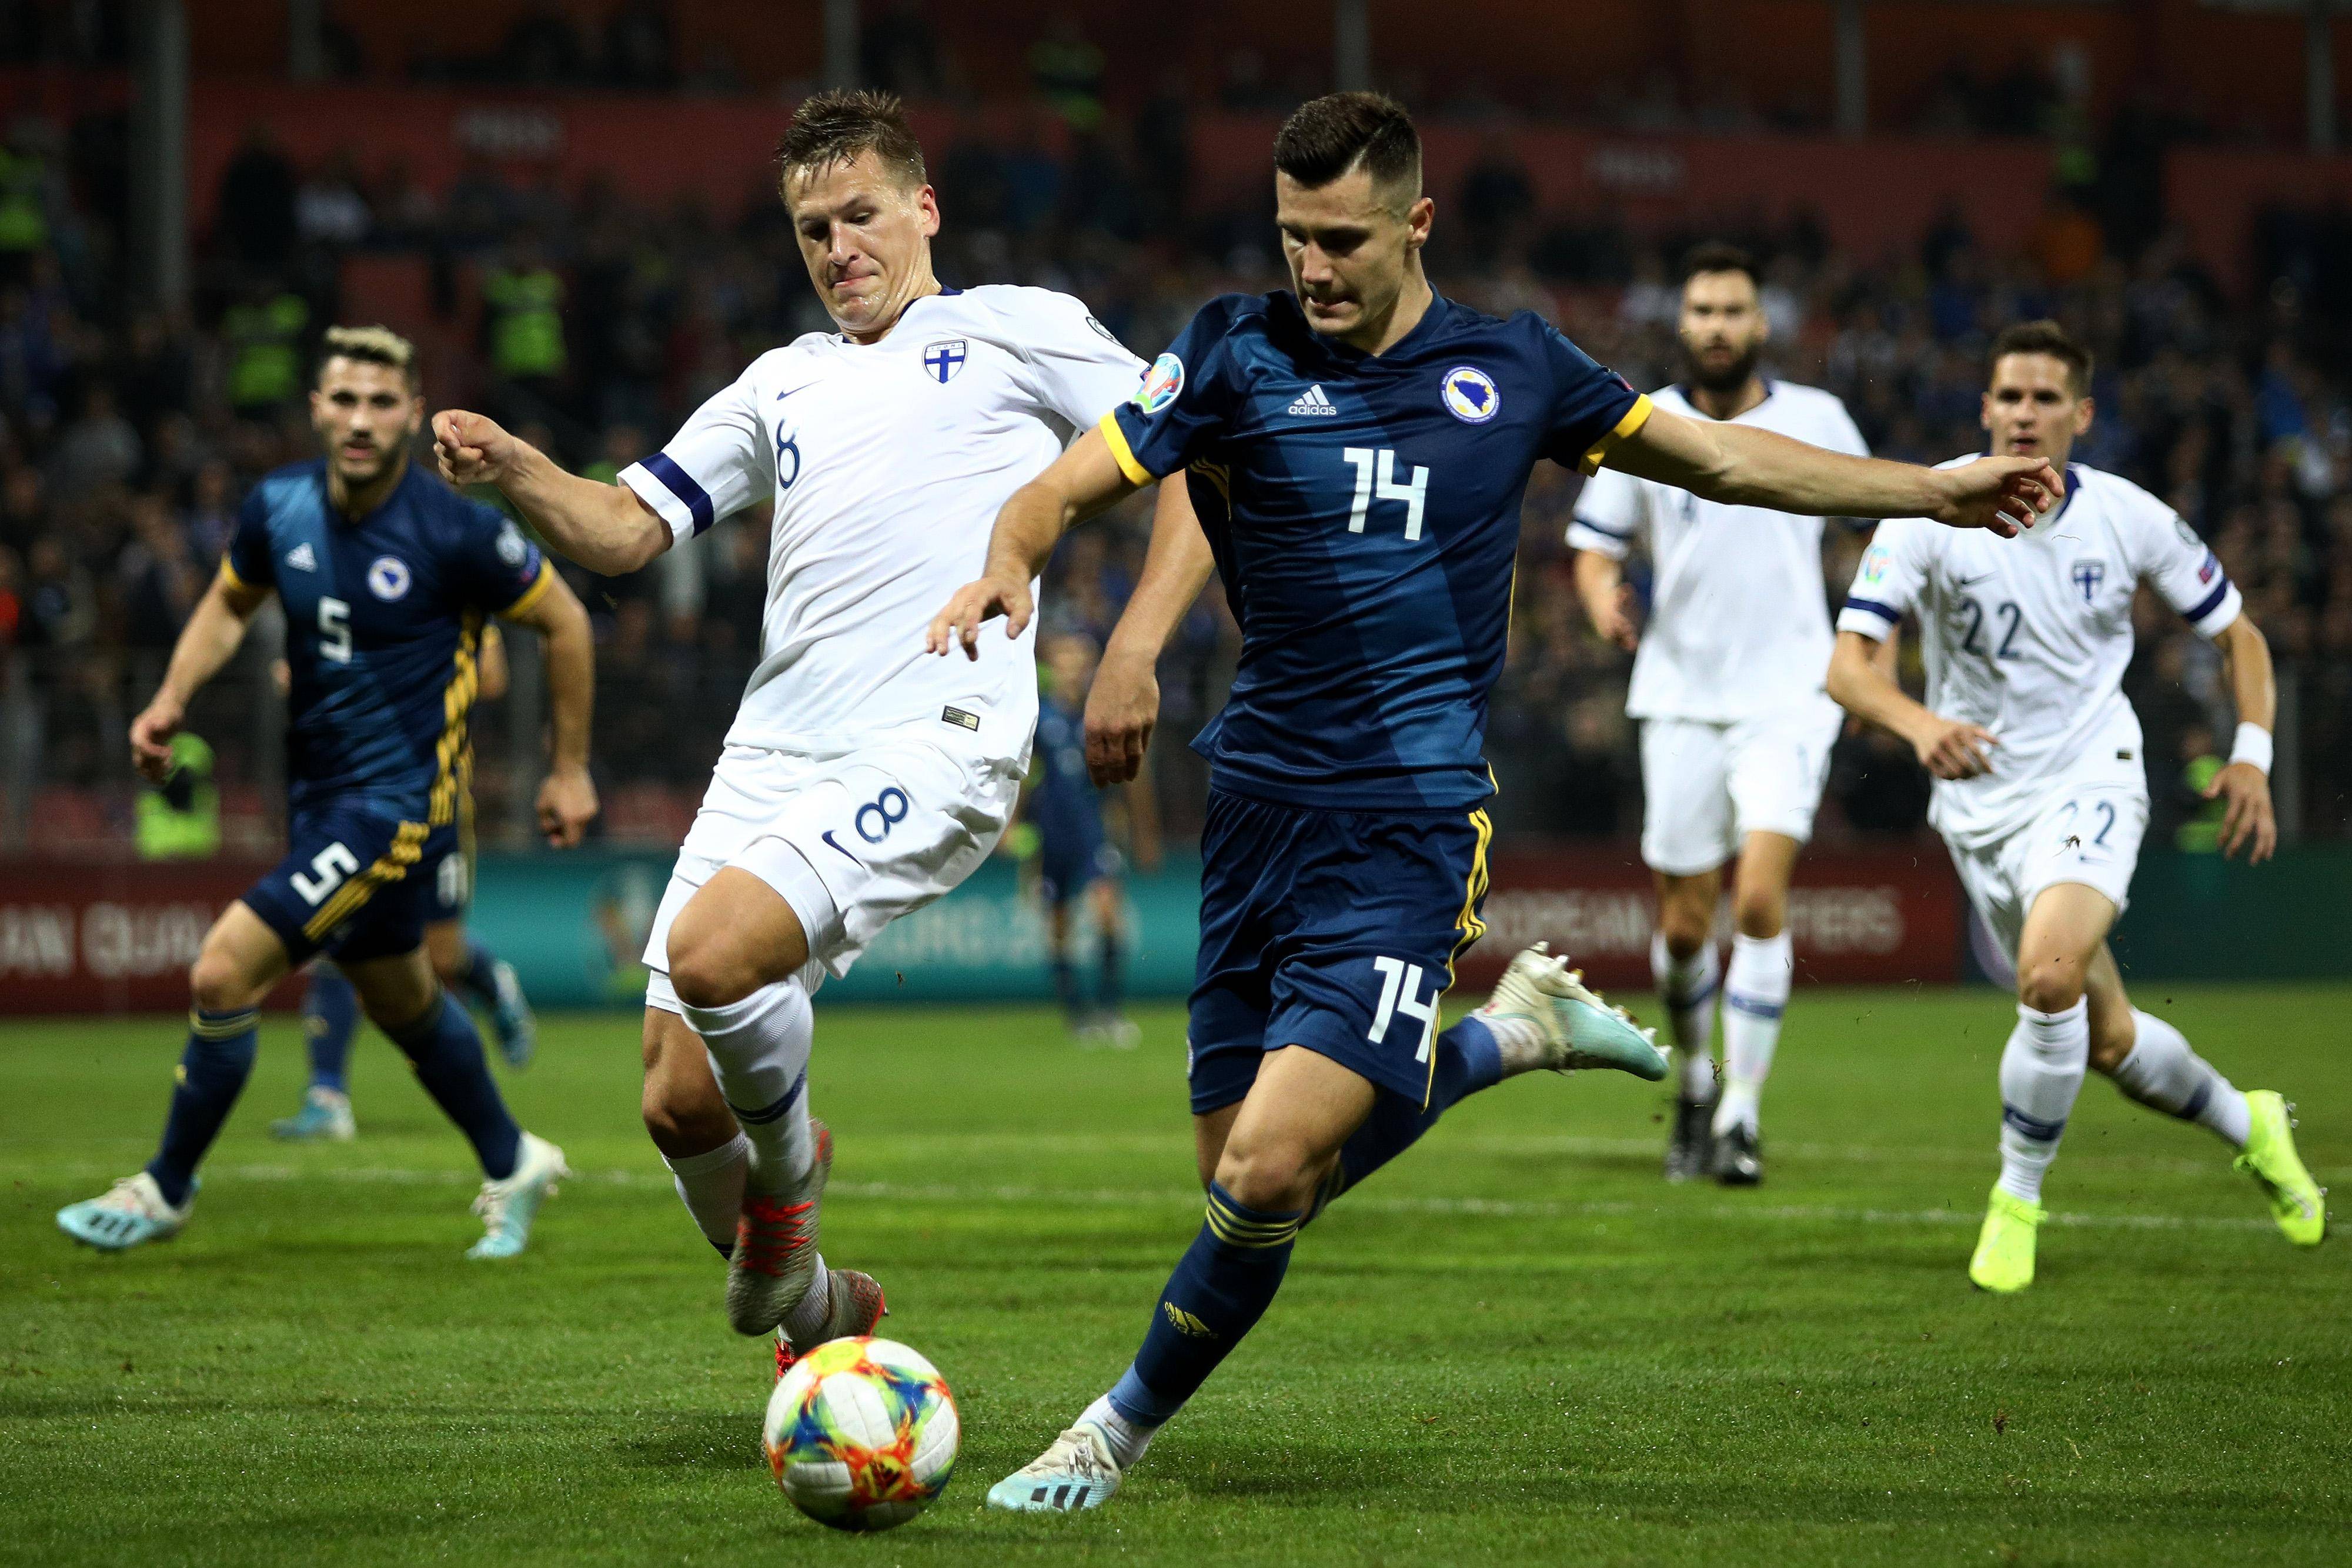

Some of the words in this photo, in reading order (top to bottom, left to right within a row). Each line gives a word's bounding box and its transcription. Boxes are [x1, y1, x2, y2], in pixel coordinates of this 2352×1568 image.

[1288, 404, 1337, 415] adidas
[776, 417, 800, 490] 8
[1344, 447, 1429, 541] 14
[318, 595, 353, 665] 5
[1961, 598, 2023, 659] 22
[855, 787, 908, 844] 8
[289, 841, 360, 907] 5
[1368, 955, 1439, 1064] 14
